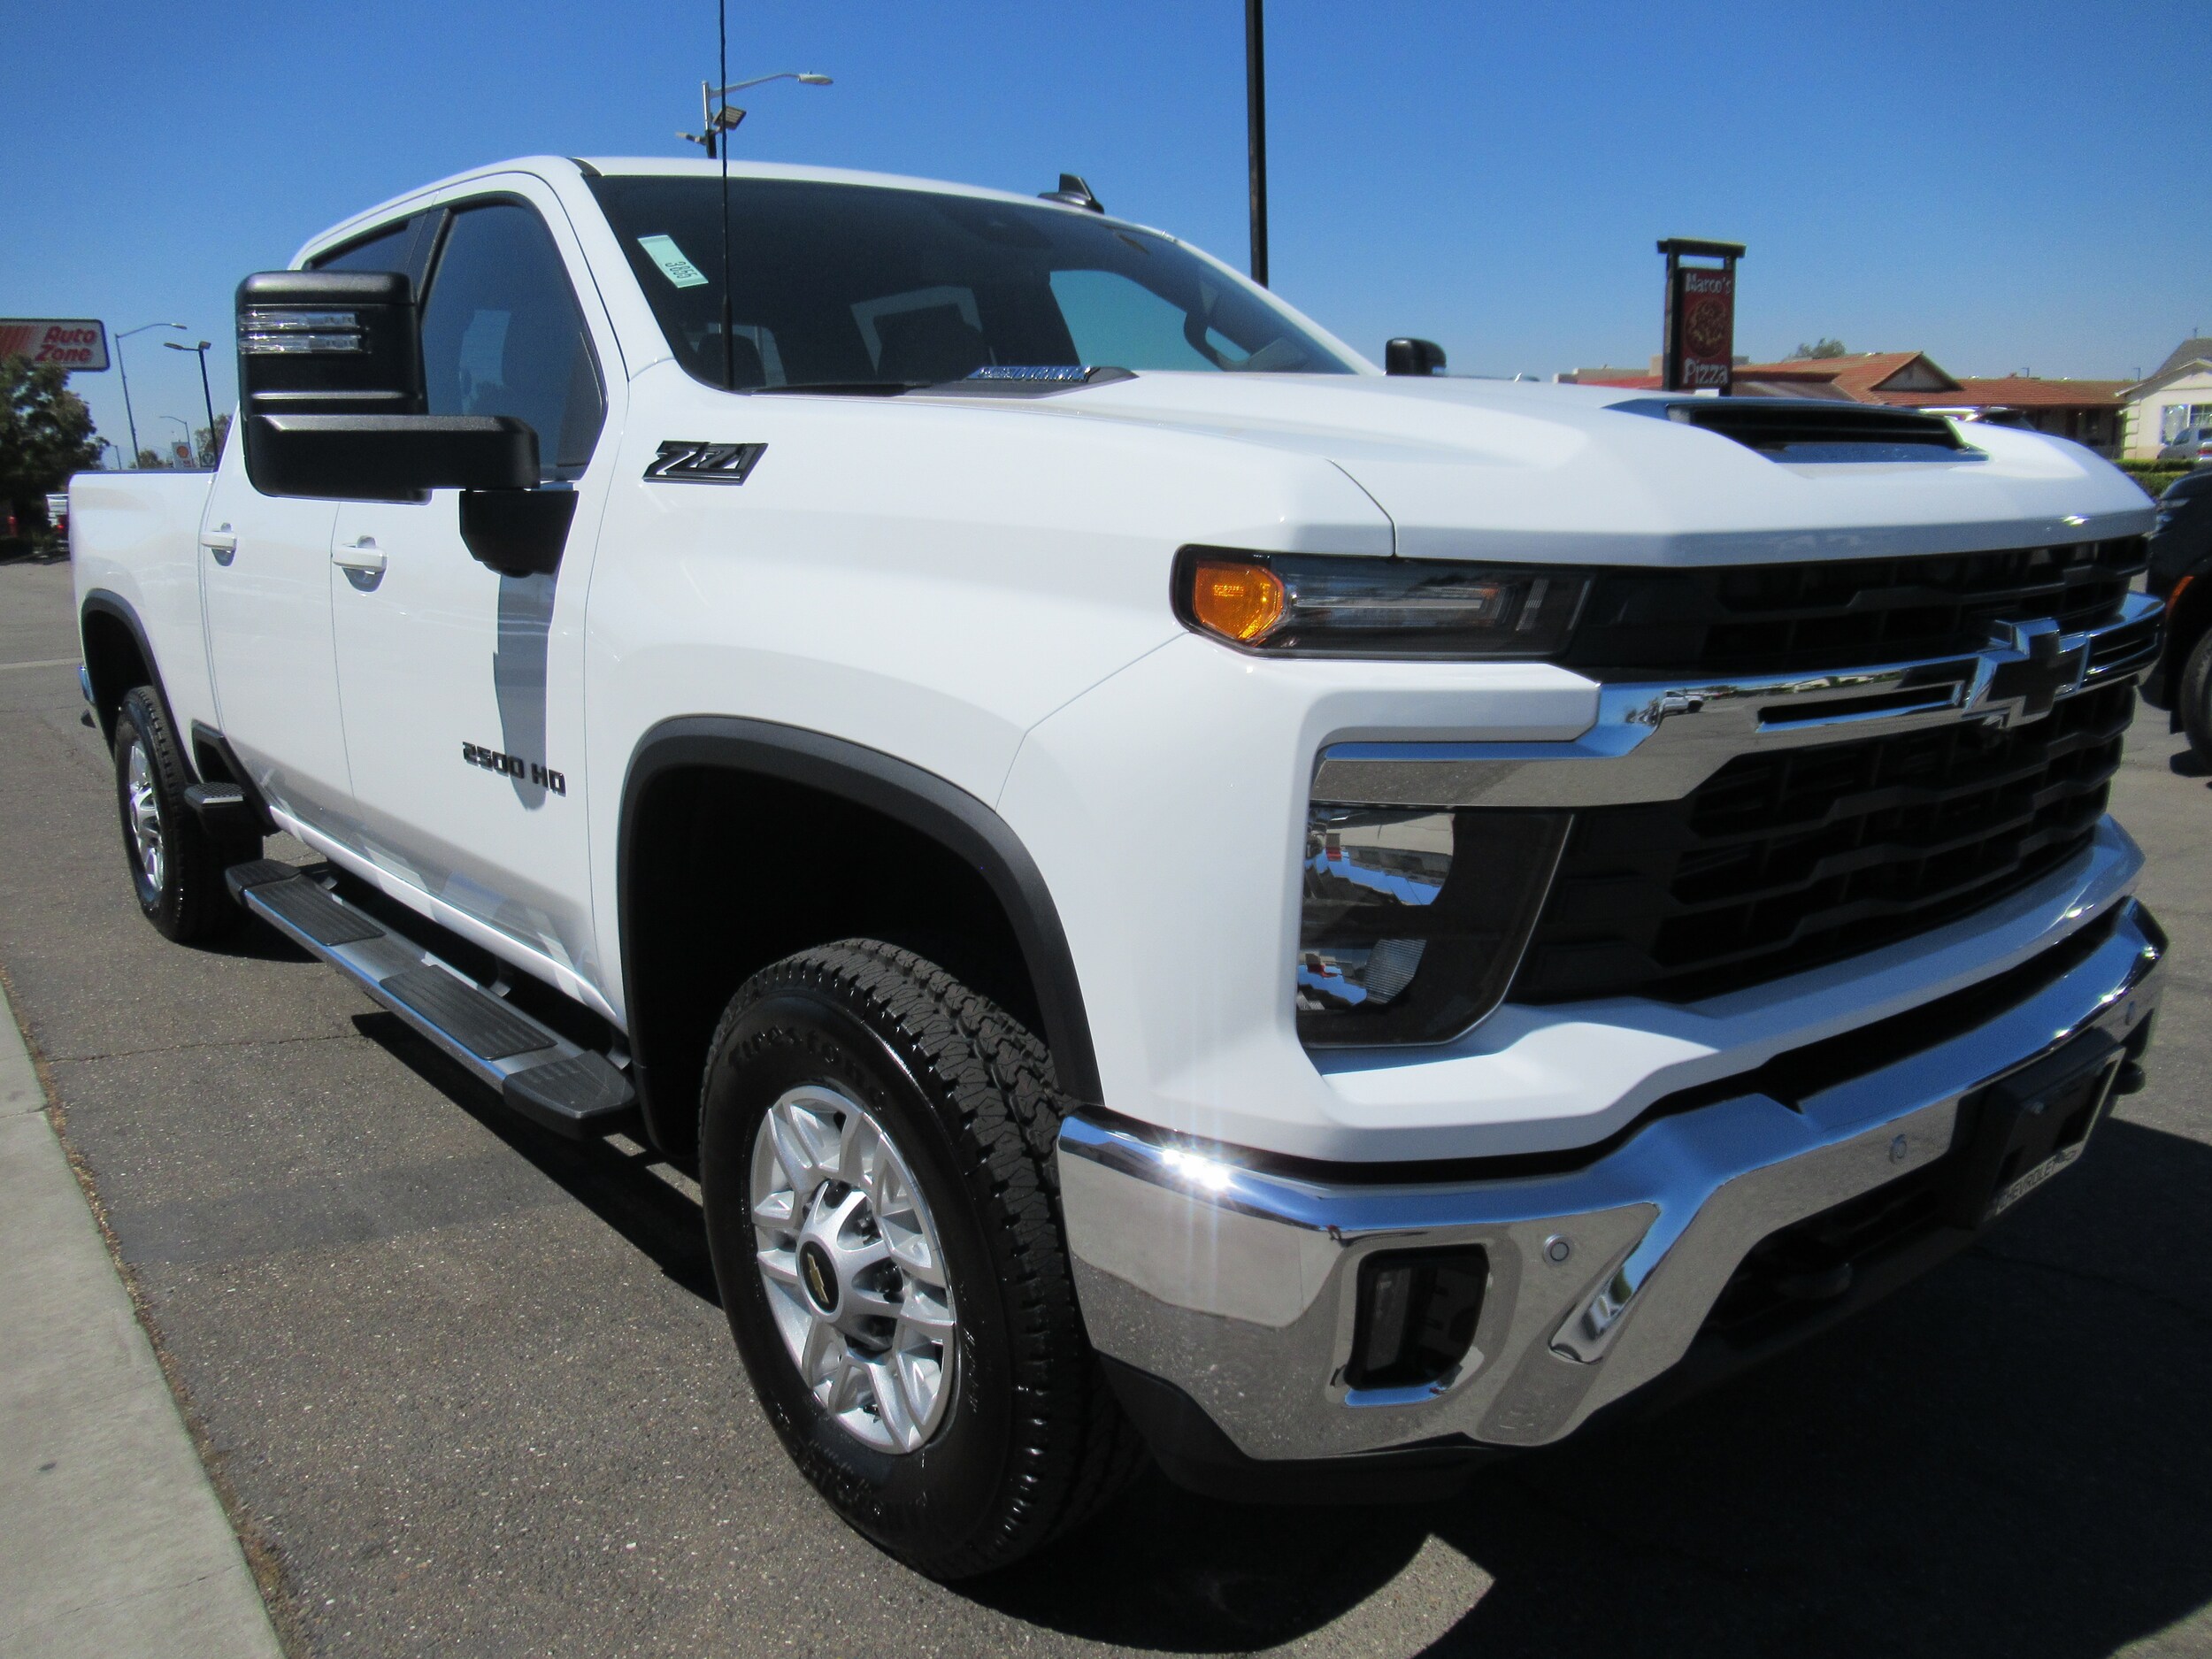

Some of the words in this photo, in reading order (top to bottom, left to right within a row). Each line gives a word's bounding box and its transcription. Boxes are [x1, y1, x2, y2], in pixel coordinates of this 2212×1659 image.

[1686, 273, 1732, 295] Marco's
[42, 326, 96, 344] Auto
[35, 343, 93, 363] Zone
[1684, 357, 1728, 386] Pizza
[641, 440, 769, 487] Z71
[462, 741, 526, 780] 2500
[531, 762, 566, 795] HD
